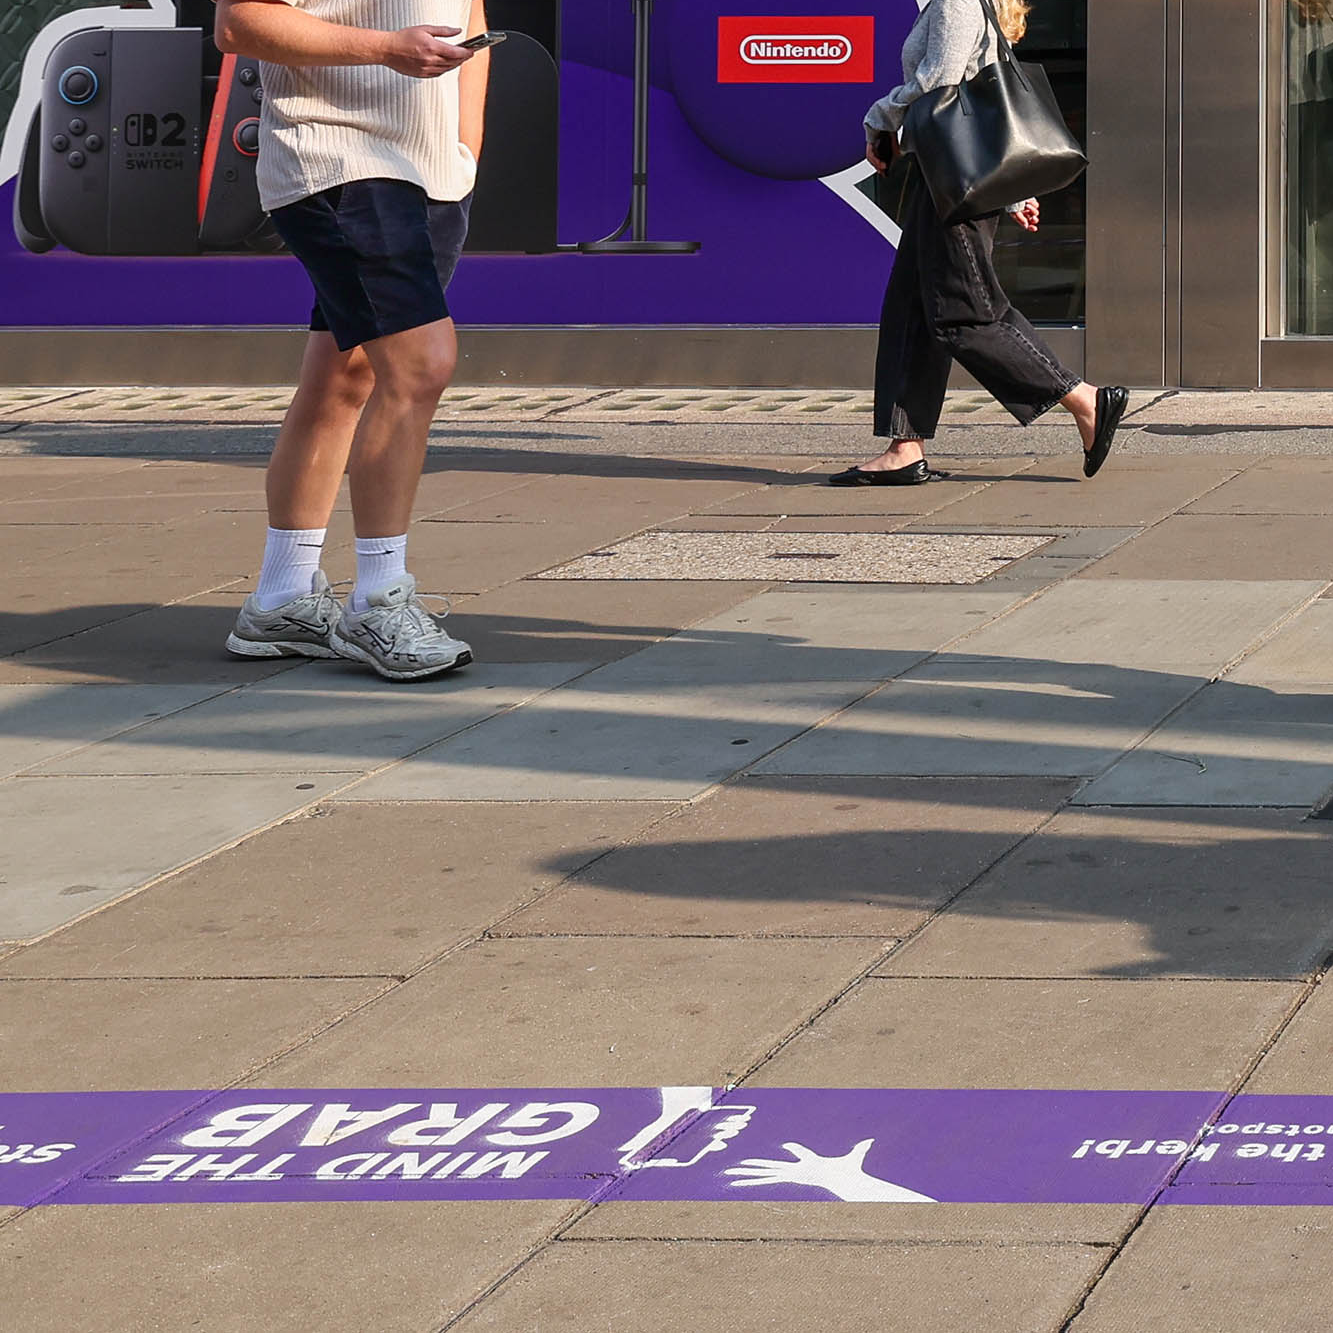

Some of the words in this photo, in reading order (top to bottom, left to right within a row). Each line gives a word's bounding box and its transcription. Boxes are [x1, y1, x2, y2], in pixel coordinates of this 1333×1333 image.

[750, 42, 842, 57] Nintendo
[125, 158, 184, 170] SWITCH
[178, 1102, 601, 1148] GRAB
[1071, 1139, 1221, 1163] kerb!
[1235, 1141, 1326, 1163] the
[116, 1153, 297, 1183] THE
[312, 1150, 551, 1181] MIND
